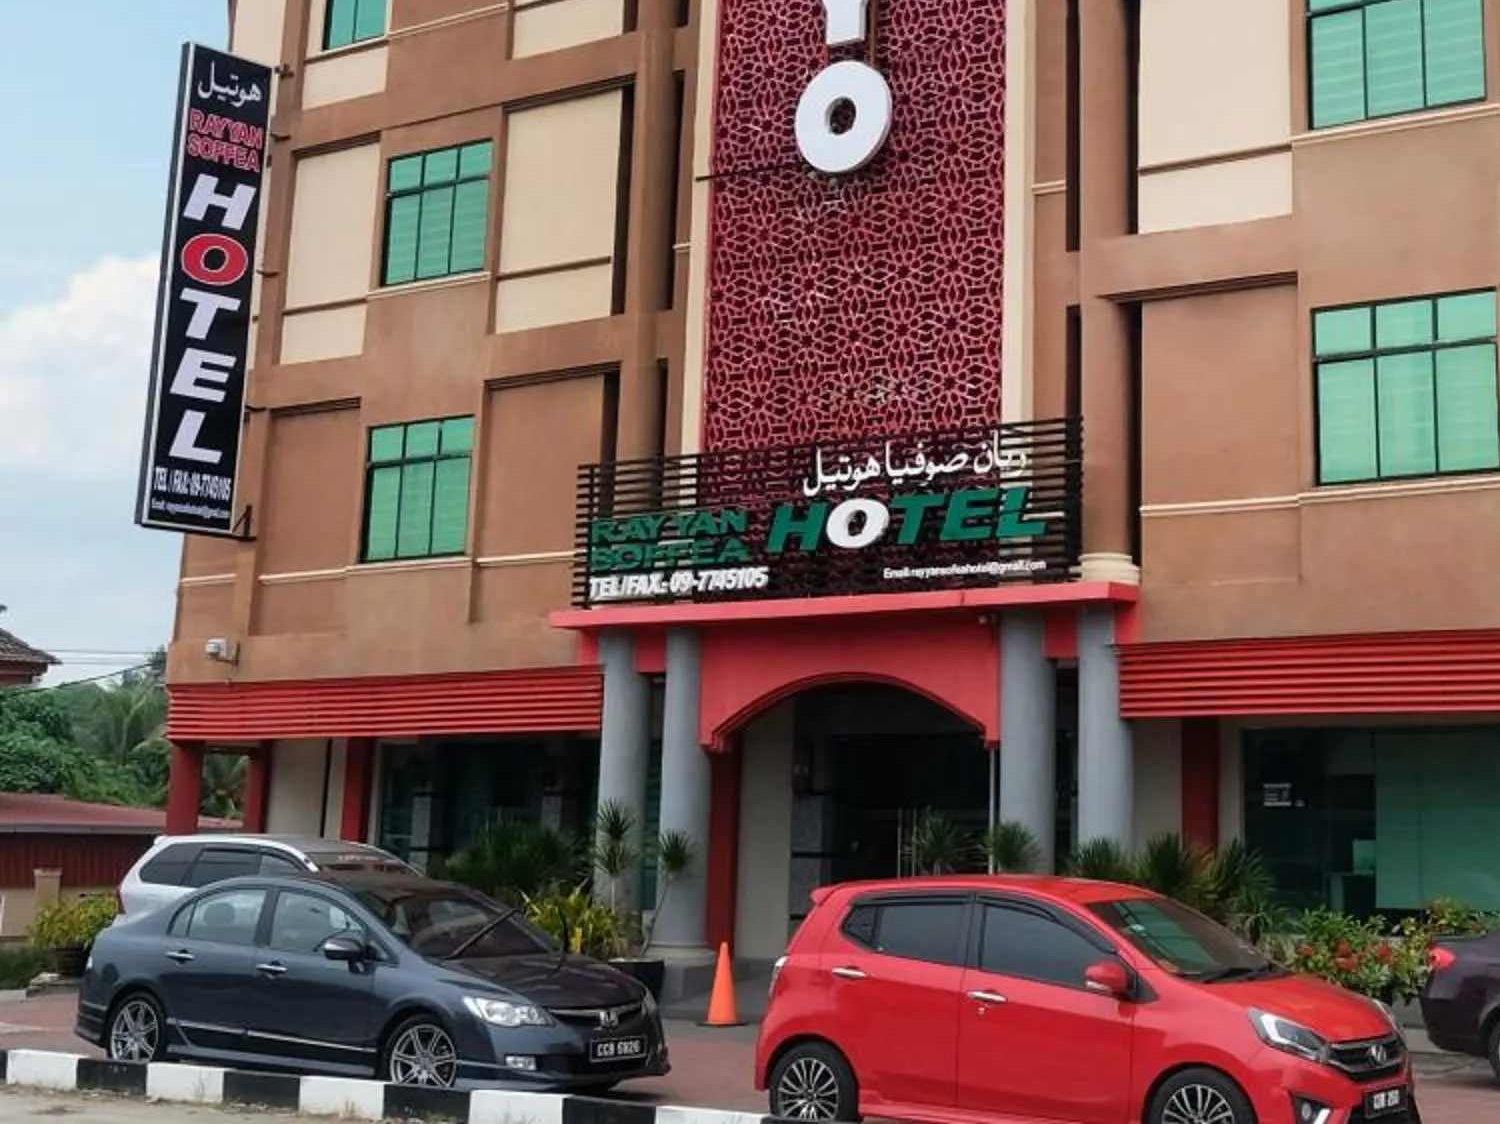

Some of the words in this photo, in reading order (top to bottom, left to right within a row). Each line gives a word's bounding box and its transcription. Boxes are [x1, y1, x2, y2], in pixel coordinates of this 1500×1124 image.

[197, 59, 262, 107] هوتيل
[168, 172, 257, 464] HOTEL
[802, 447, 881, 497] هوتيل
[767, 486, 1048, 553] HOTEL
